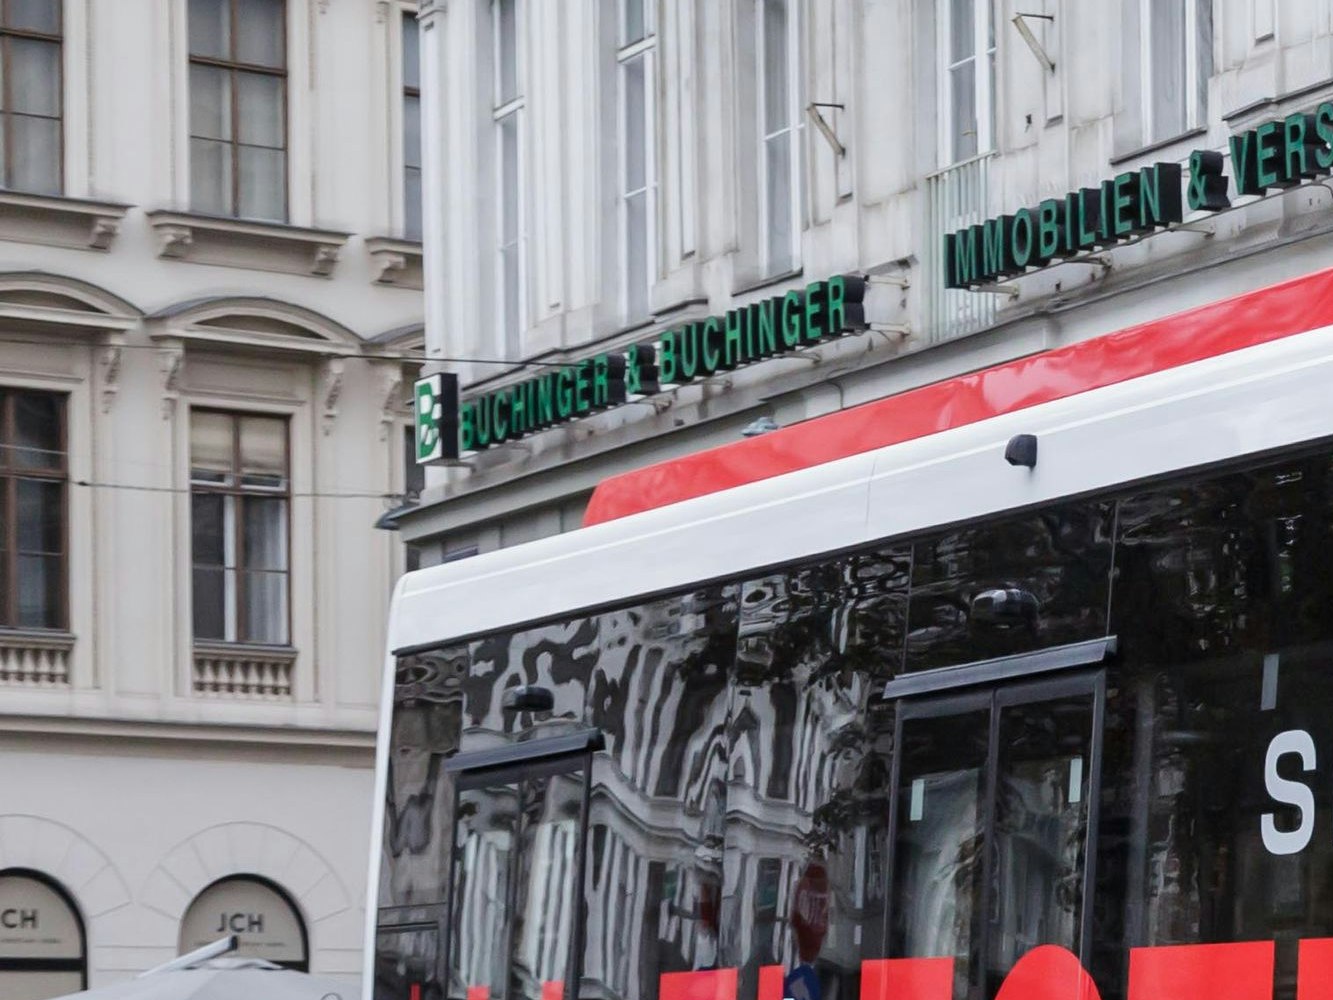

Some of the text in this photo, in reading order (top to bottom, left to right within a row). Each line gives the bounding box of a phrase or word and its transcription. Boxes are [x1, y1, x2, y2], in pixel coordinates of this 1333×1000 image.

[944, 163, 1160, 288] IMMOBILIEN
[1187, 150, 1208, 210] &
[461, 353, 610, 451] BUCHINGER
[659, 275, 845, 384] BUCHINGER
[217, 912, 265, 933] JCH
